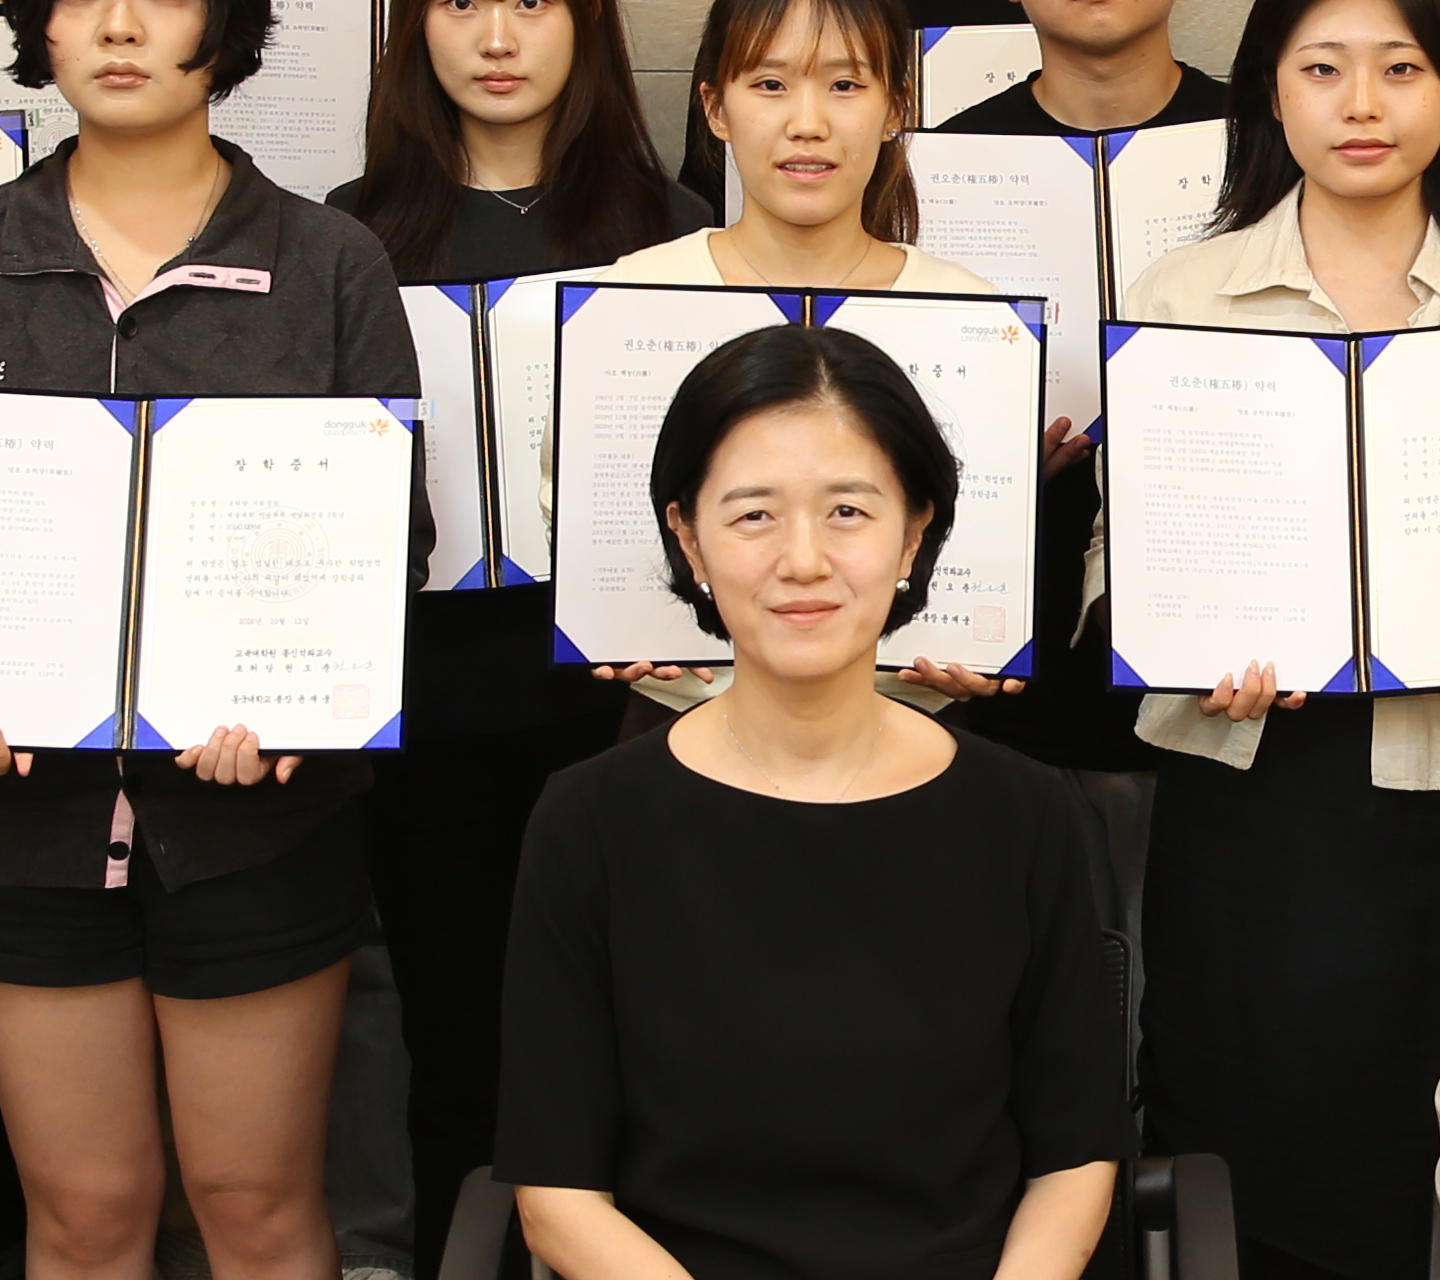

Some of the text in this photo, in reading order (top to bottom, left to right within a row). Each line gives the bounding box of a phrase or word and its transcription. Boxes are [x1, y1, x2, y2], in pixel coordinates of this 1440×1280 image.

[1179, 174, 1211, 189] 장 학
[961, 326, 999, 335] dongguk
[905, 364, 965, 382] 학 증 서
[324, 420, 367, 431] dongguk
[235, 458, 328, 471] 장 학 증 서
